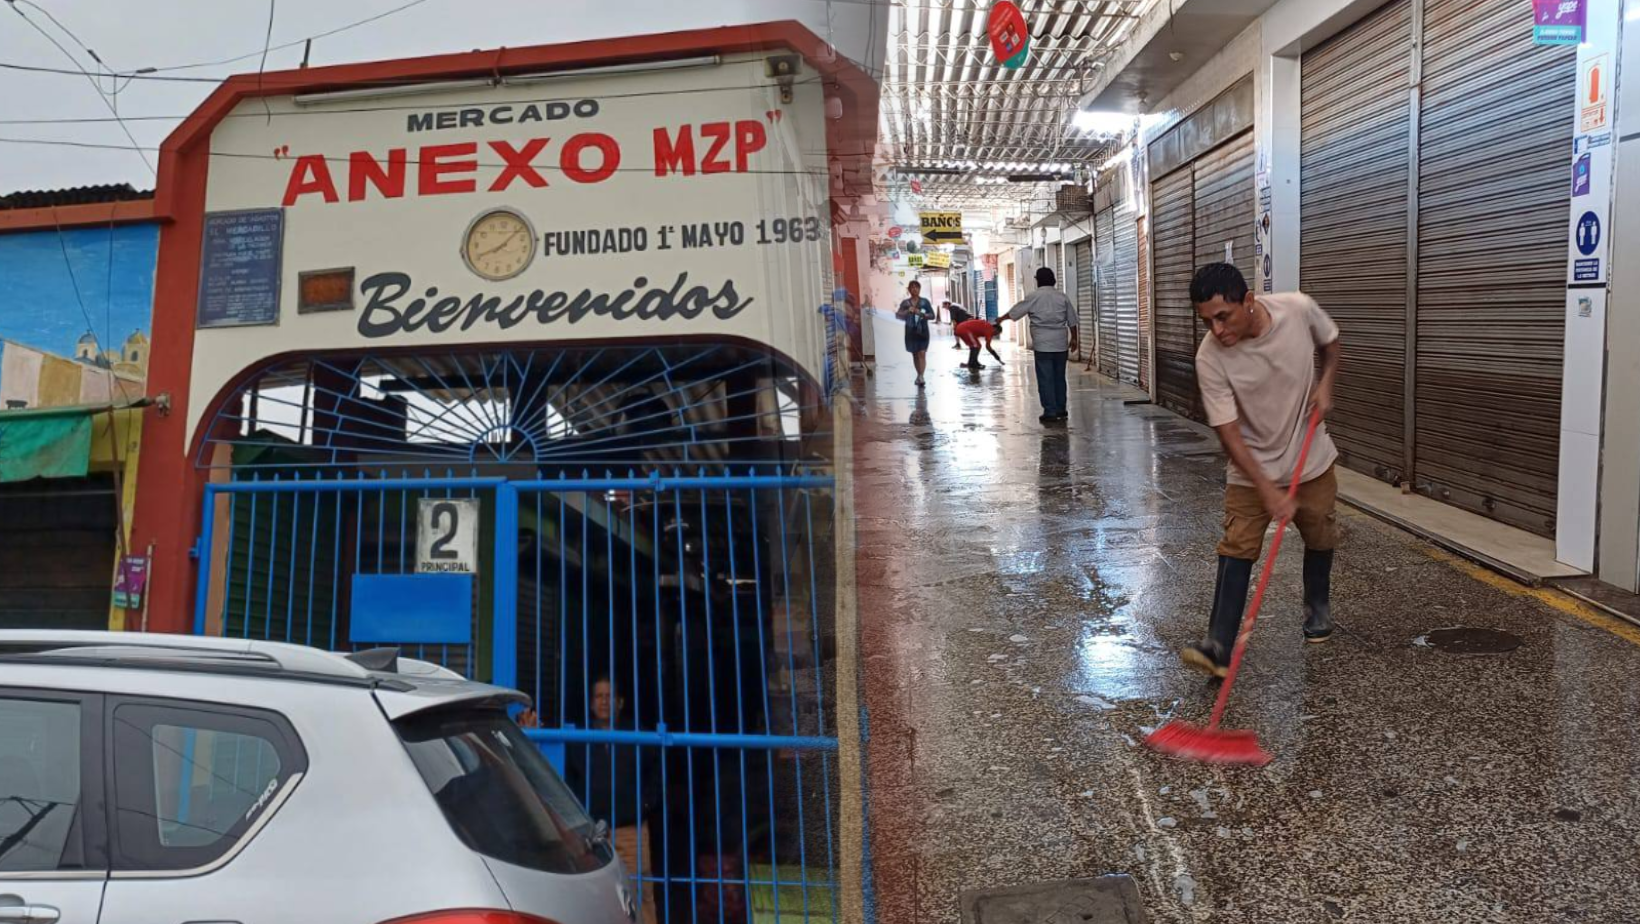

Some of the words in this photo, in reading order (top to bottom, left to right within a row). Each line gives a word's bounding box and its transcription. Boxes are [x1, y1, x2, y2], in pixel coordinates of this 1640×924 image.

[407, 99, 600, 132] MERCADO
[544, 226, 648, 256] FUNDADO
[681, 220, 745, 248] MAYO
[756, 216, 820, 244] 1963
[357, 271, 753, 338] Bienvenidos
[430, 502, 459, 559] 2
[421, 562, 470, 572] PRINCIPAL
